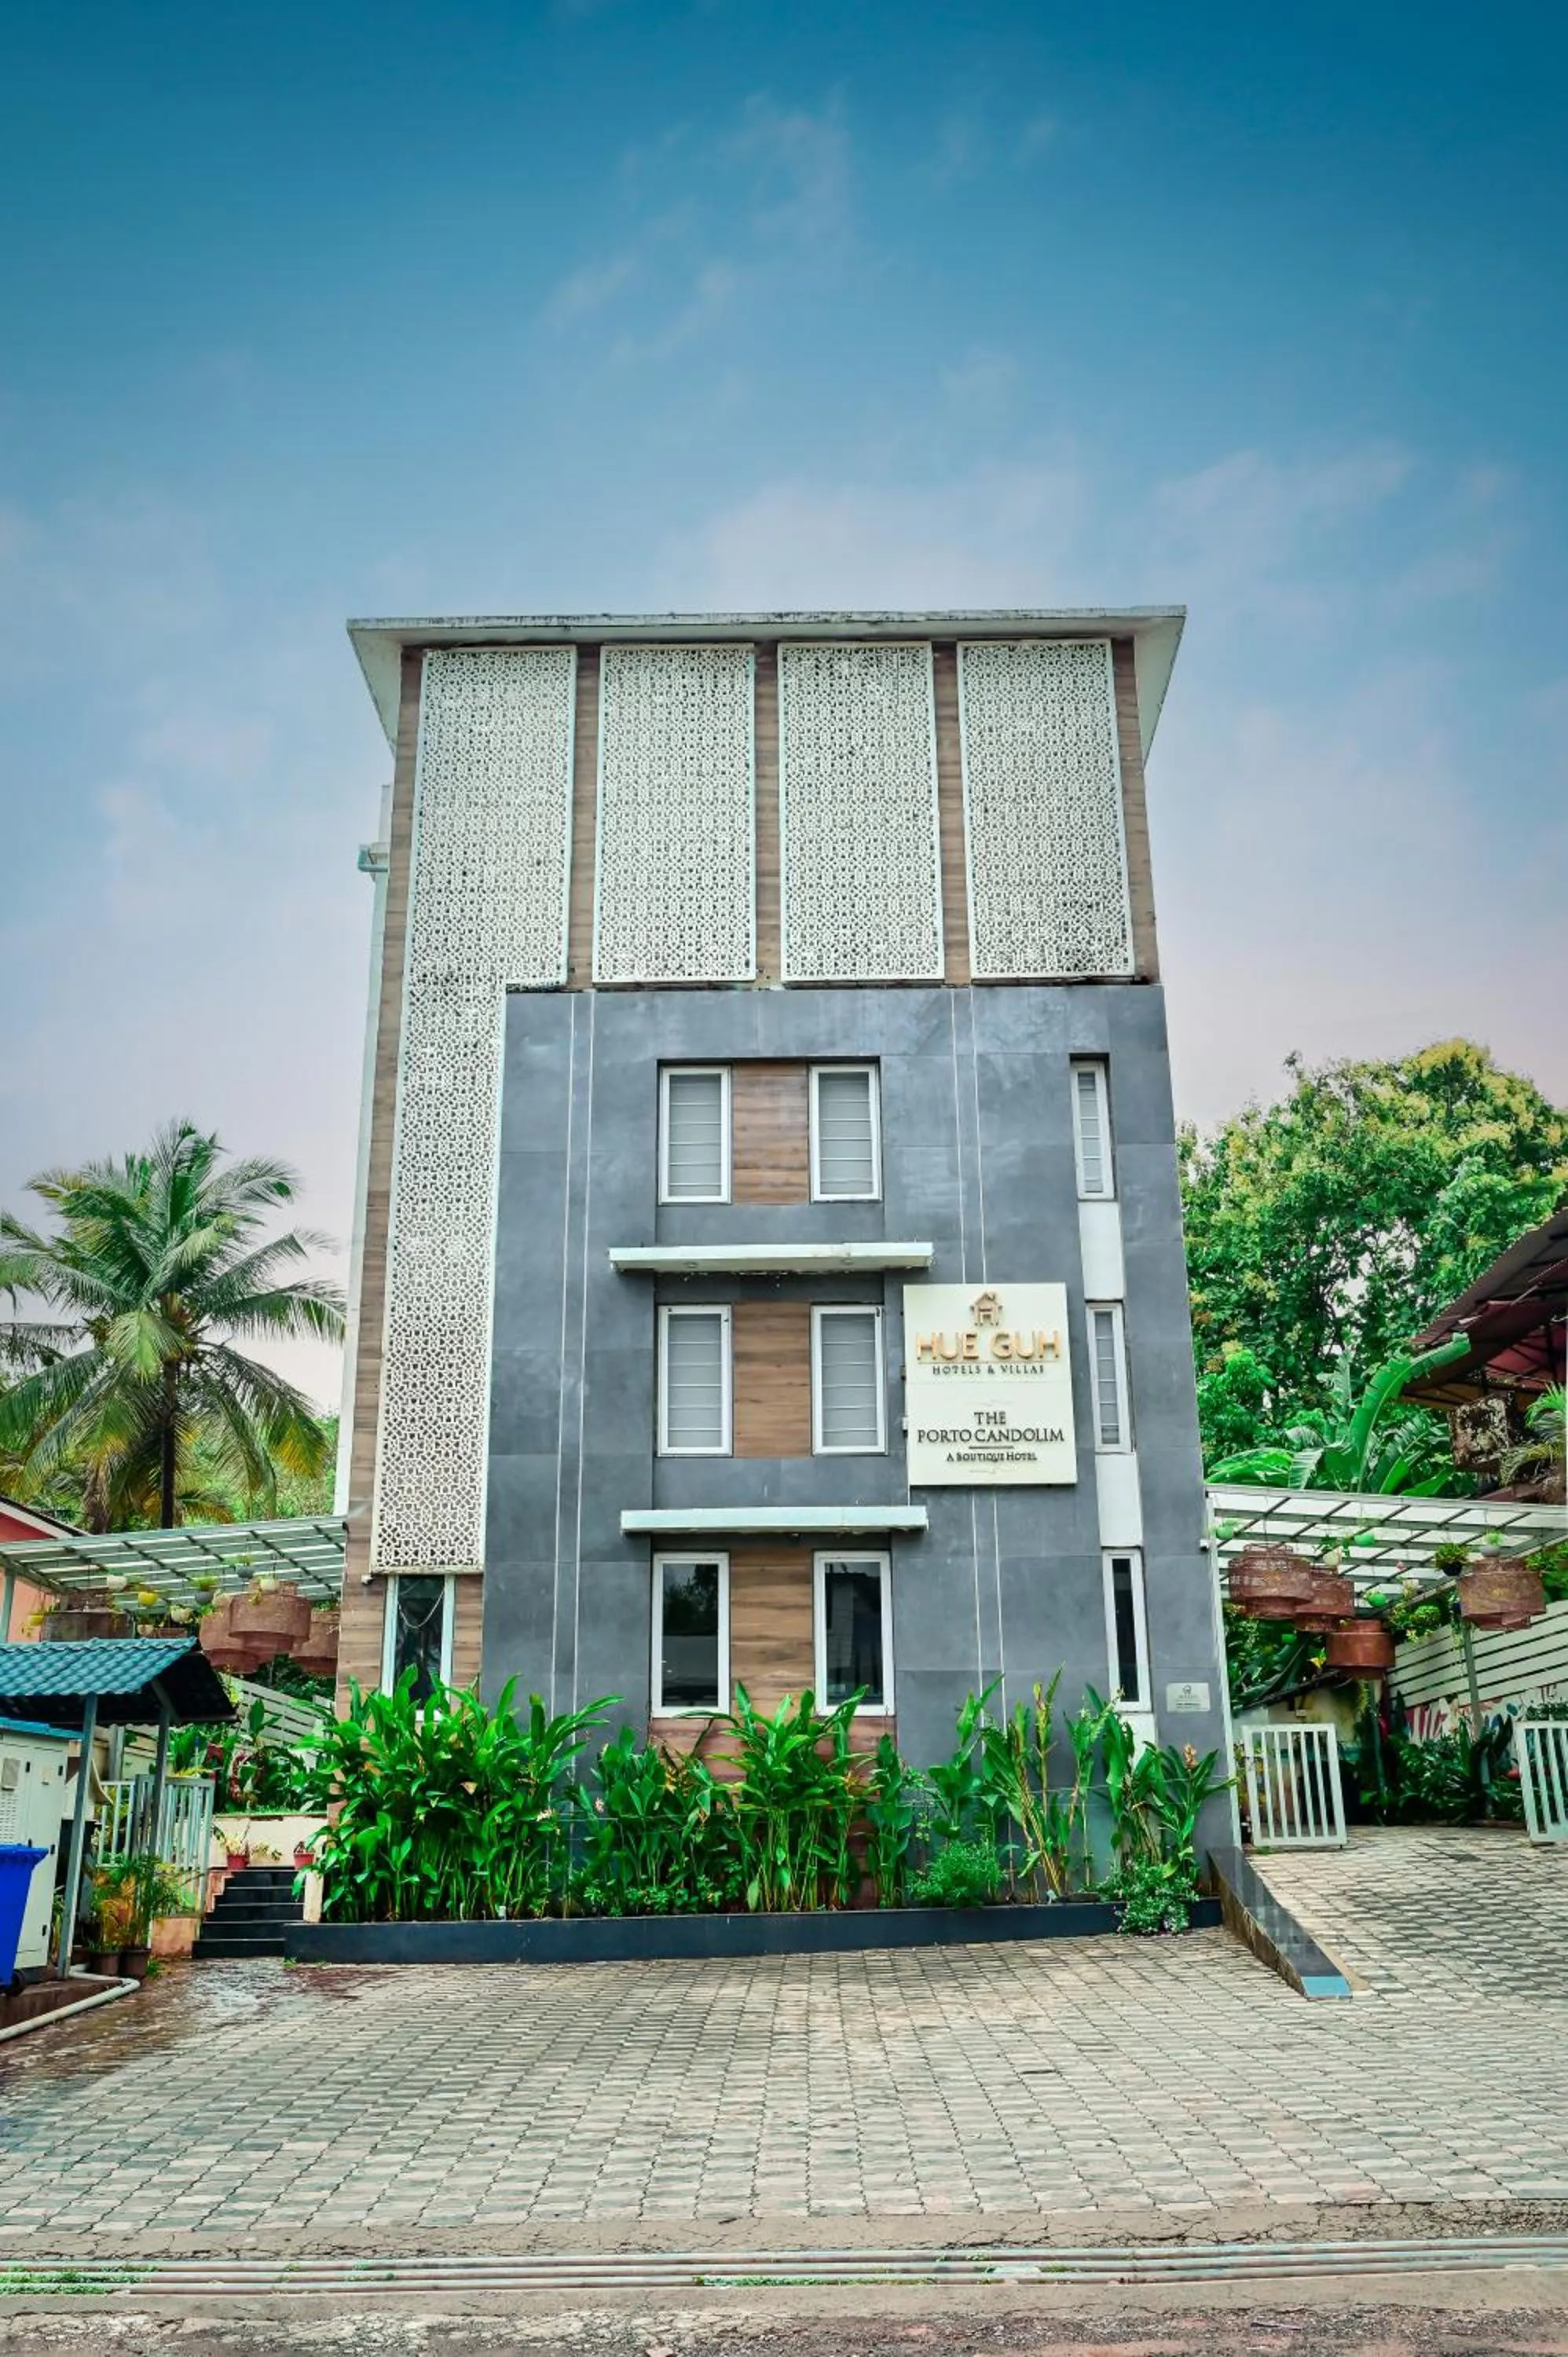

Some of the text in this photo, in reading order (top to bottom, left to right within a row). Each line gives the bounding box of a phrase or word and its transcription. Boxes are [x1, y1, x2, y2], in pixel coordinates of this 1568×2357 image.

[917, 1331, 1060, 1360] HUE GUH
[932, 1365, 1045, 1375] HOTELS & VILLAS
[974, 1411, 1006, 1424] THE
[918, 1427, 1064, 1443] PORTO CANDOLIM
[946, 1452, 1037, 1463] A BOUTIQUE HOTEL
